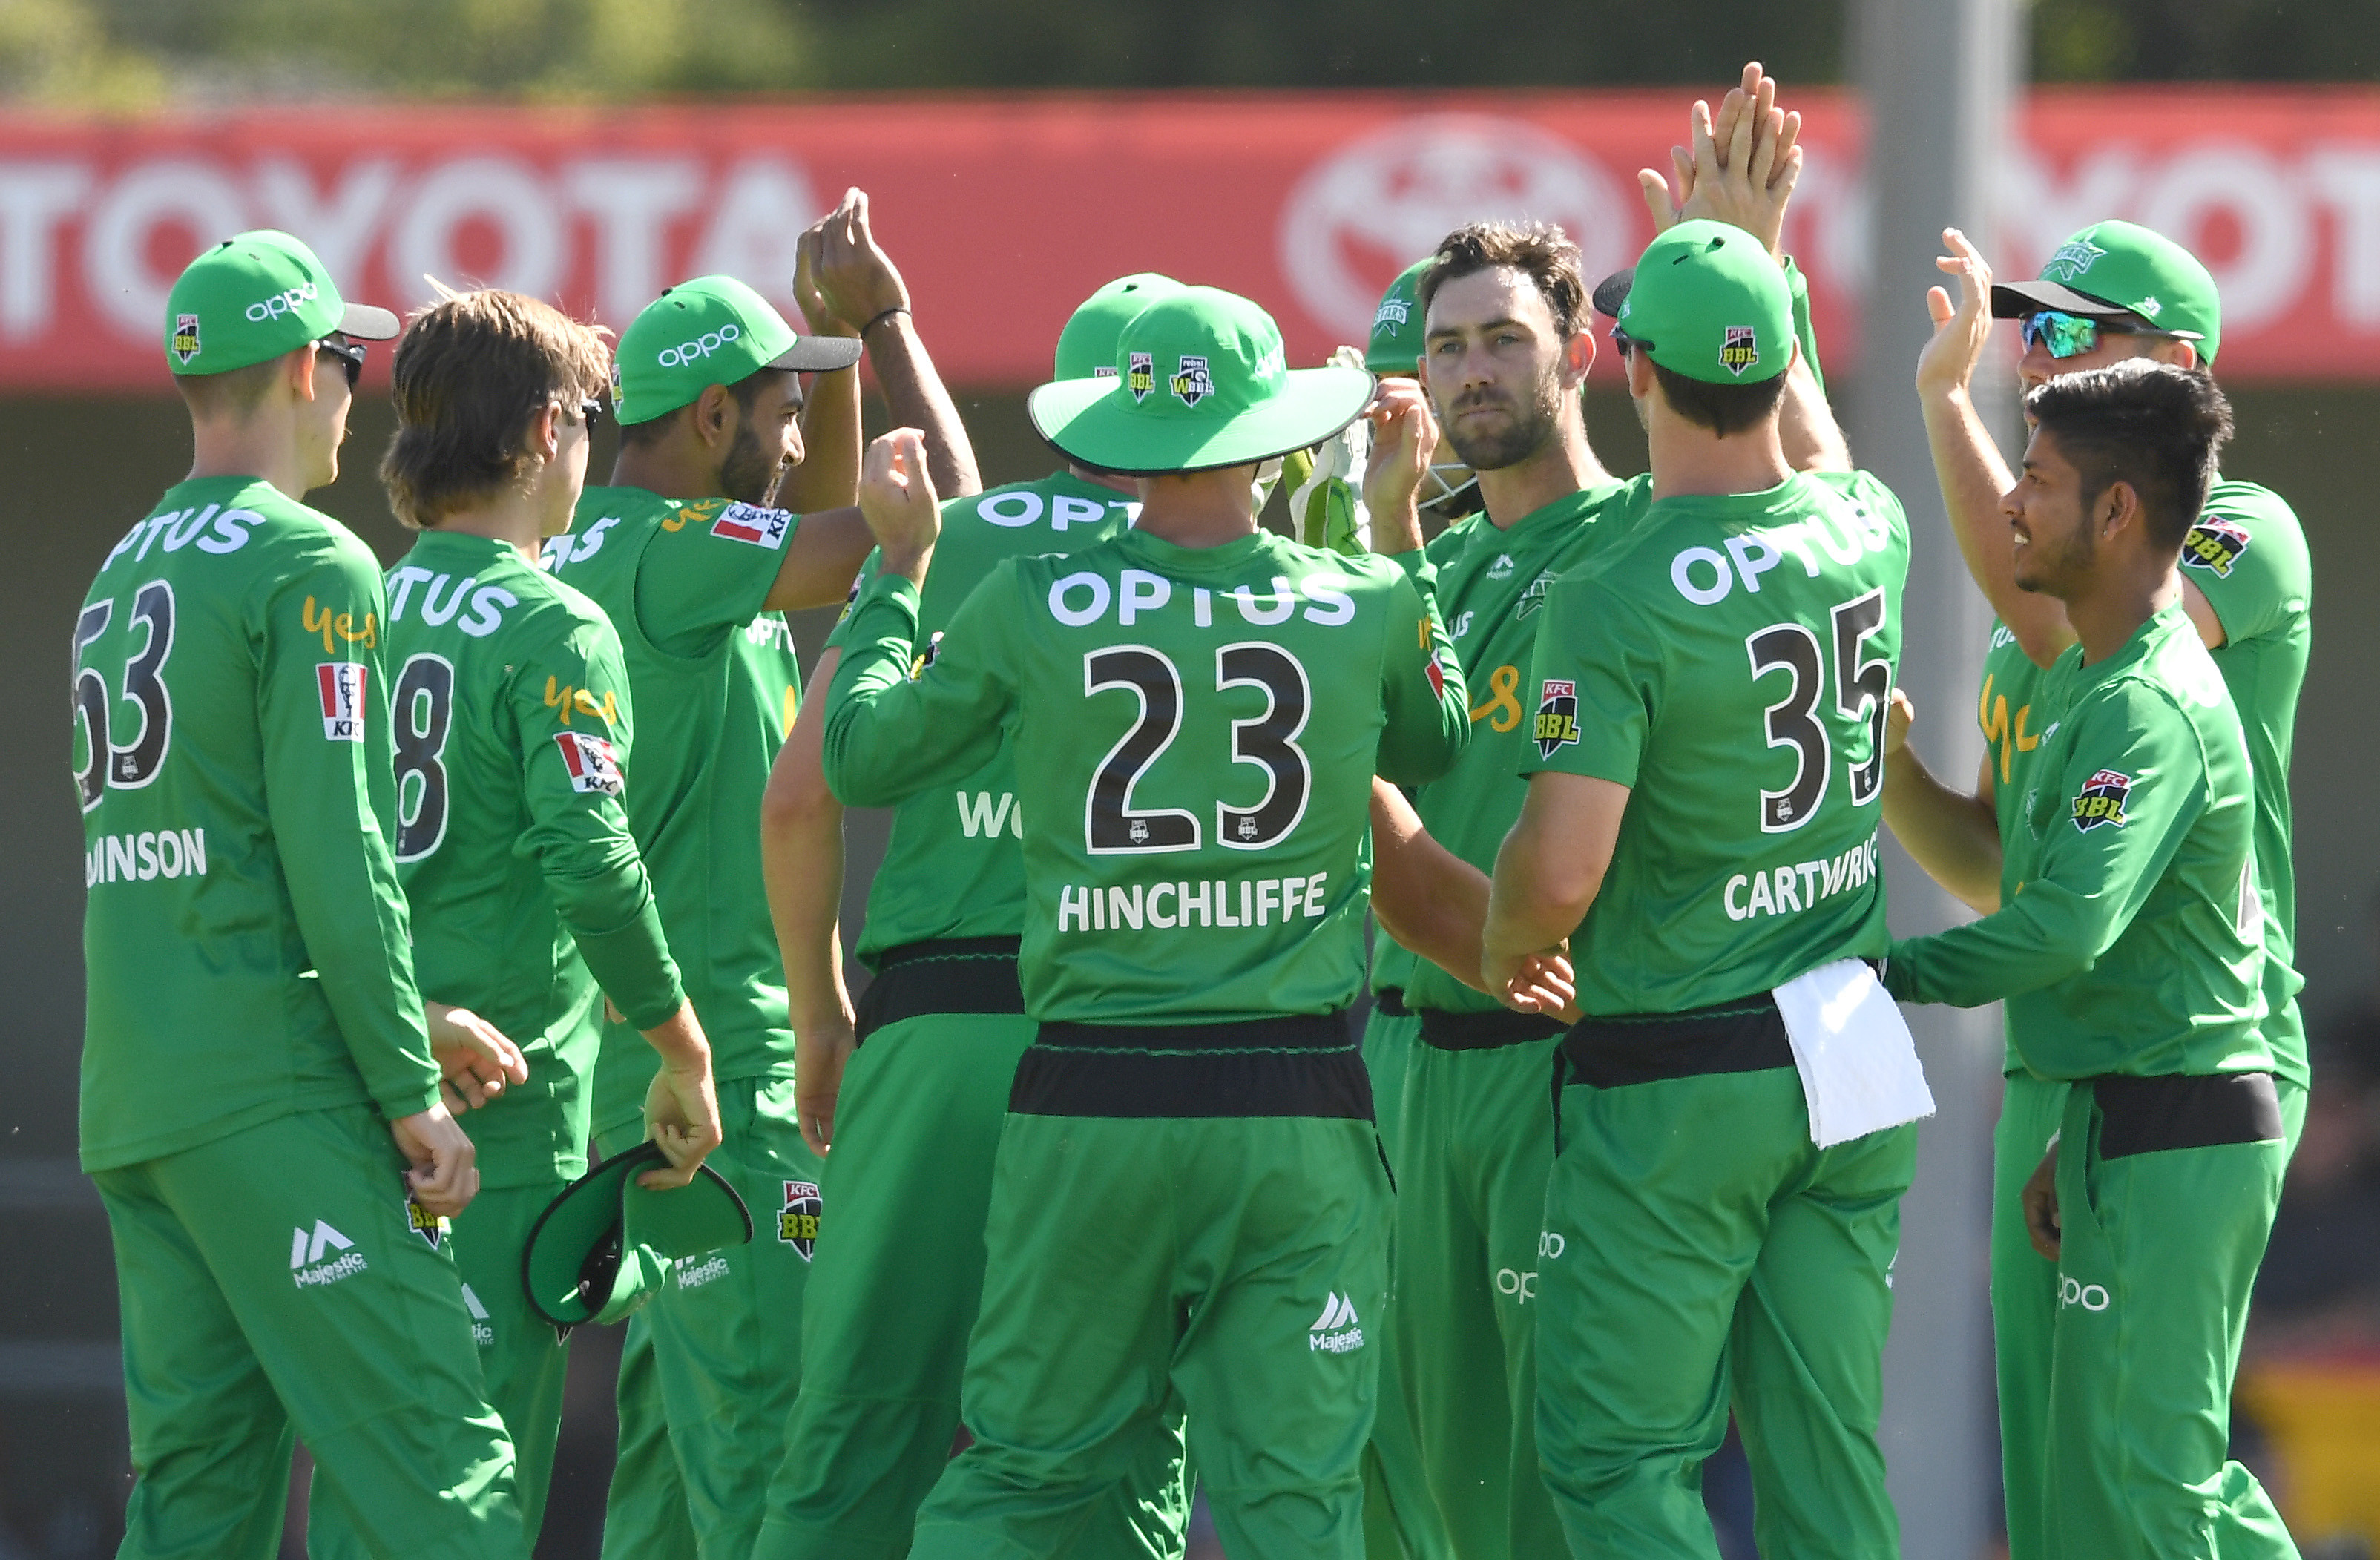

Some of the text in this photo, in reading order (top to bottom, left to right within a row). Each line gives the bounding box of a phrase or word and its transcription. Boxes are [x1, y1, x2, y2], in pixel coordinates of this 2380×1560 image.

[246, 282, 318, 321] oppo
[658, 323, 740, 367] oppo
[1723, 347, 1756, 363] BBL
[1130, 372, 1154, 390] BBL
[1173, 377, 1213, 395] WBBL
[1671, 498, 1888, 605] OPTUS
[1048, 570, 1355, 628] OPTUS
[302, 595, 377, 654] yes
[72, 579, 175, 814] 53
[544, 675, 617, 726] yes
[1546, 684, 1570, 695] KFC
[1536, 714, 1577, 740] BBL
[1746, 585, 1891, 833] 35
[392, 651, 454, 864] 8
[1083, 641, 1312, 855] 23
[2091, 771, 2124, 786] KFC
[2073, 797, 2123, 824] BBL
[1059, 872, 1327, 932] HINCHLIFFE
[791, 1185, 815, 1196] KFC
[780, 1214, 821, 1239] BB
[294, 1253, 364, 1288] Majestic
[677, 1257, 727, 1289] Majestic
[2057, 1272, 2110, 1311] po
[1309, 1327, 1362, 1352] Majestic
